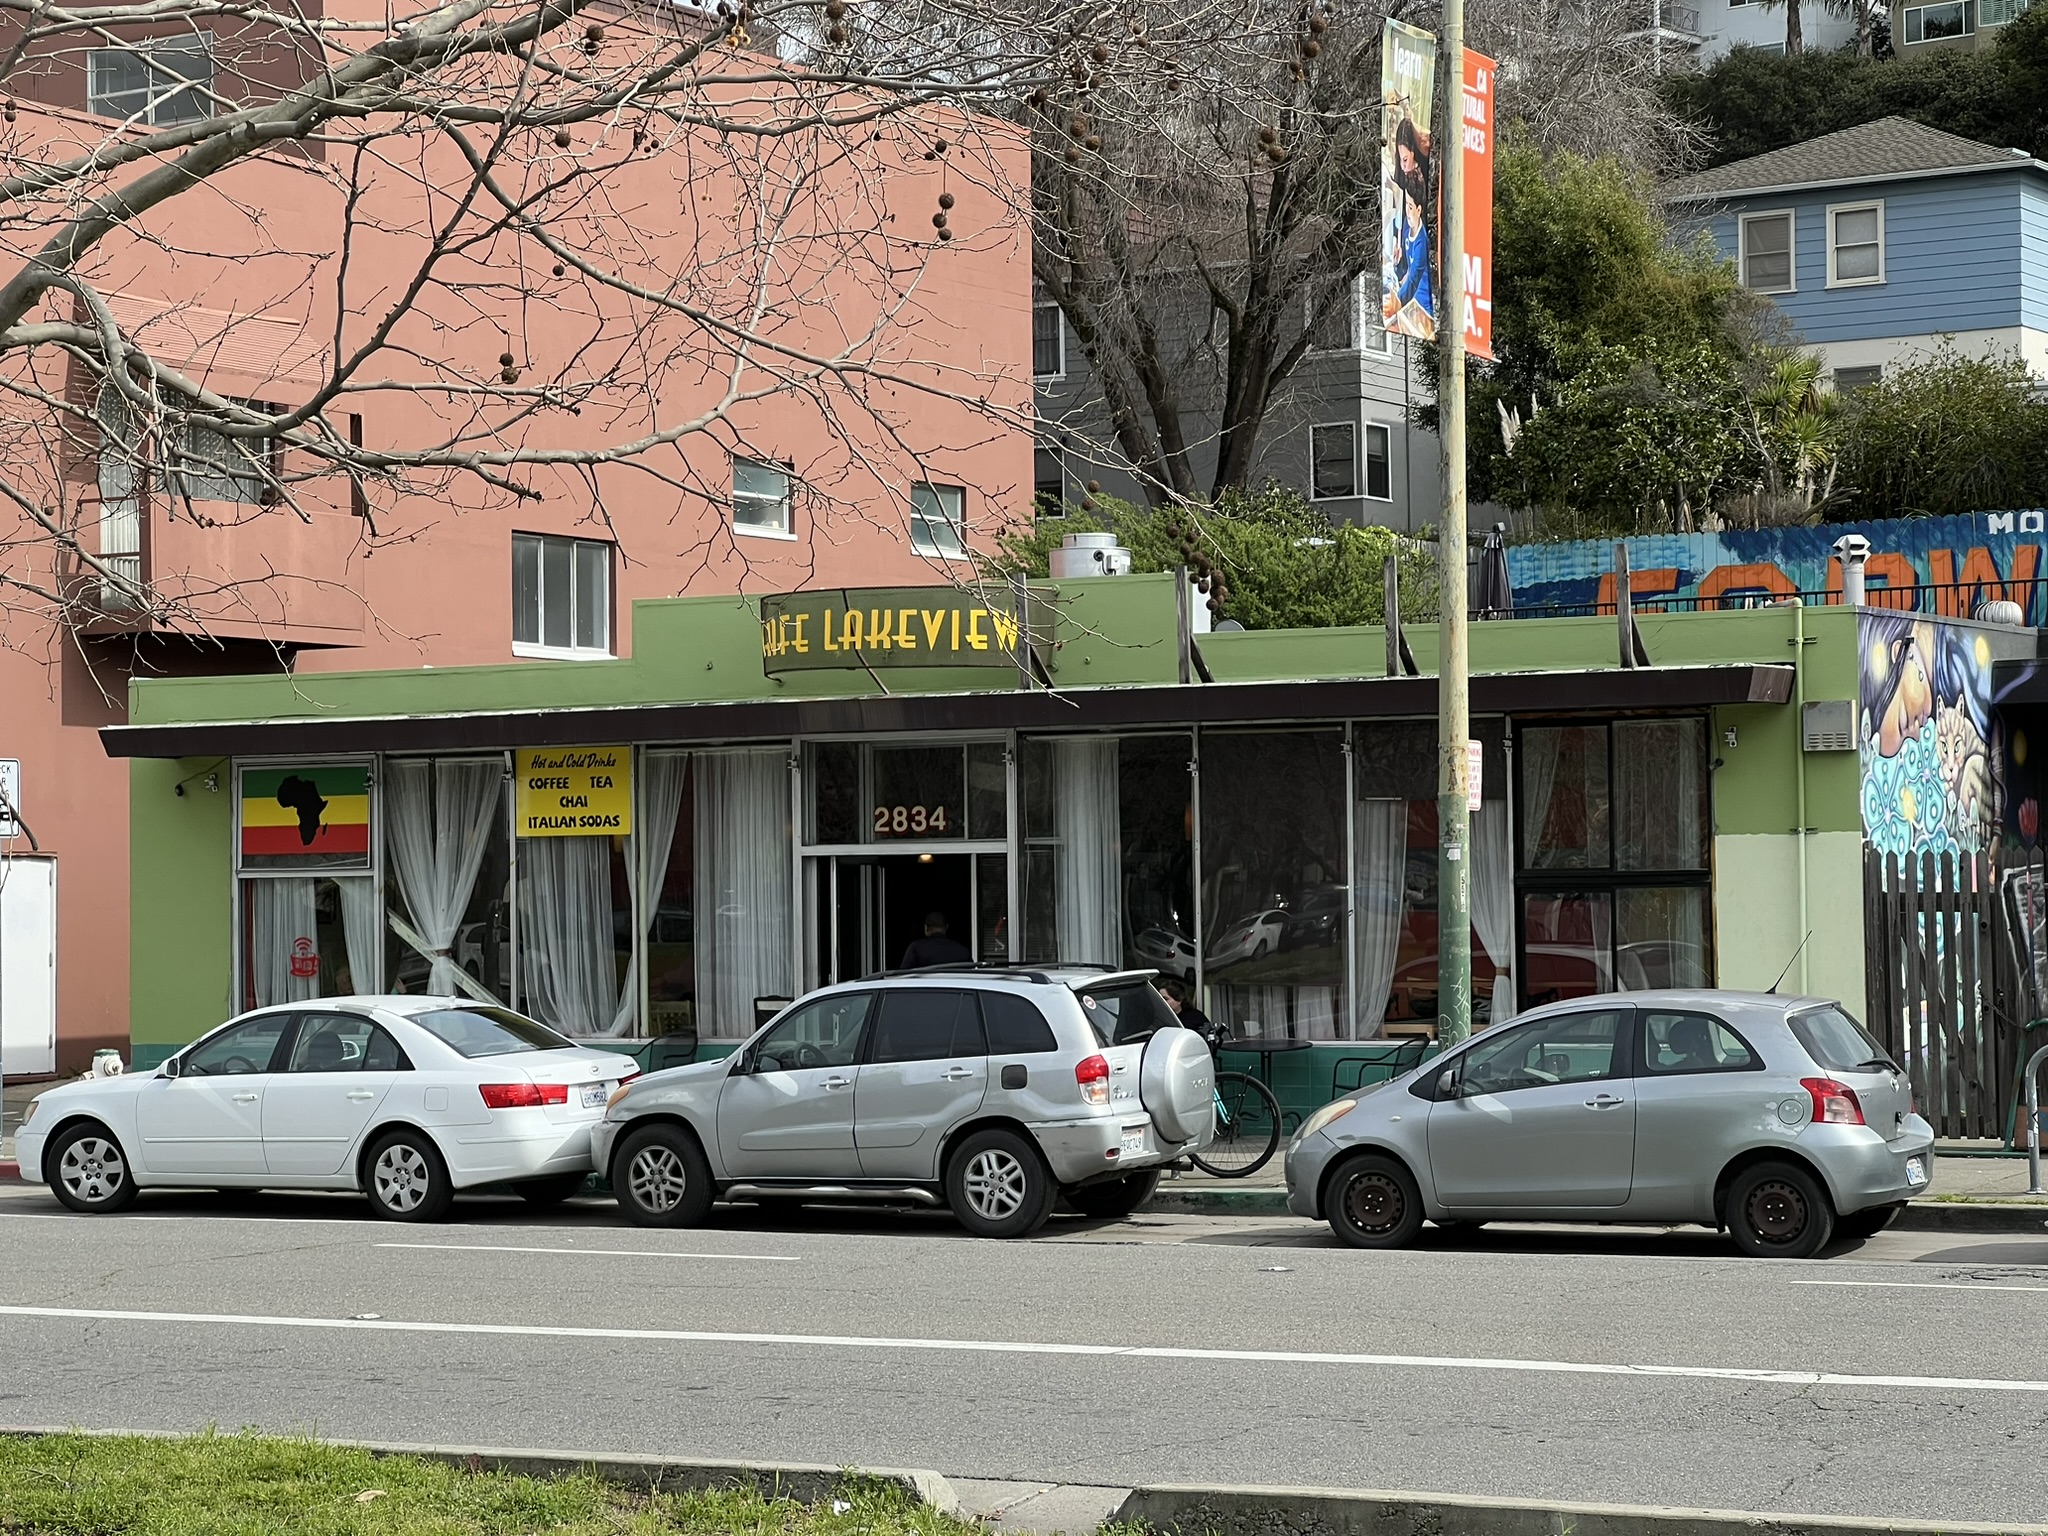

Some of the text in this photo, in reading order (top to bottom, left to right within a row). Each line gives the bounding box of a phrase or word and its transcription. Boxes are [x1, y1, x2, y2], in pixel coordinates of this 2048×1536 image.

[1393, 37, 1422, 80] learn
[763, 608, 1018, 657] AFE LAKEVIEW
[531, 753, 617, 769] Hot and Cold Drinks
[528, 776, 613, 790] COFFEE TEA
[559, 795, 588, 808] CHAI
[528, 815, 620, 829] ITALIAN SODAS
[874, 805, 946, 832] 2834
